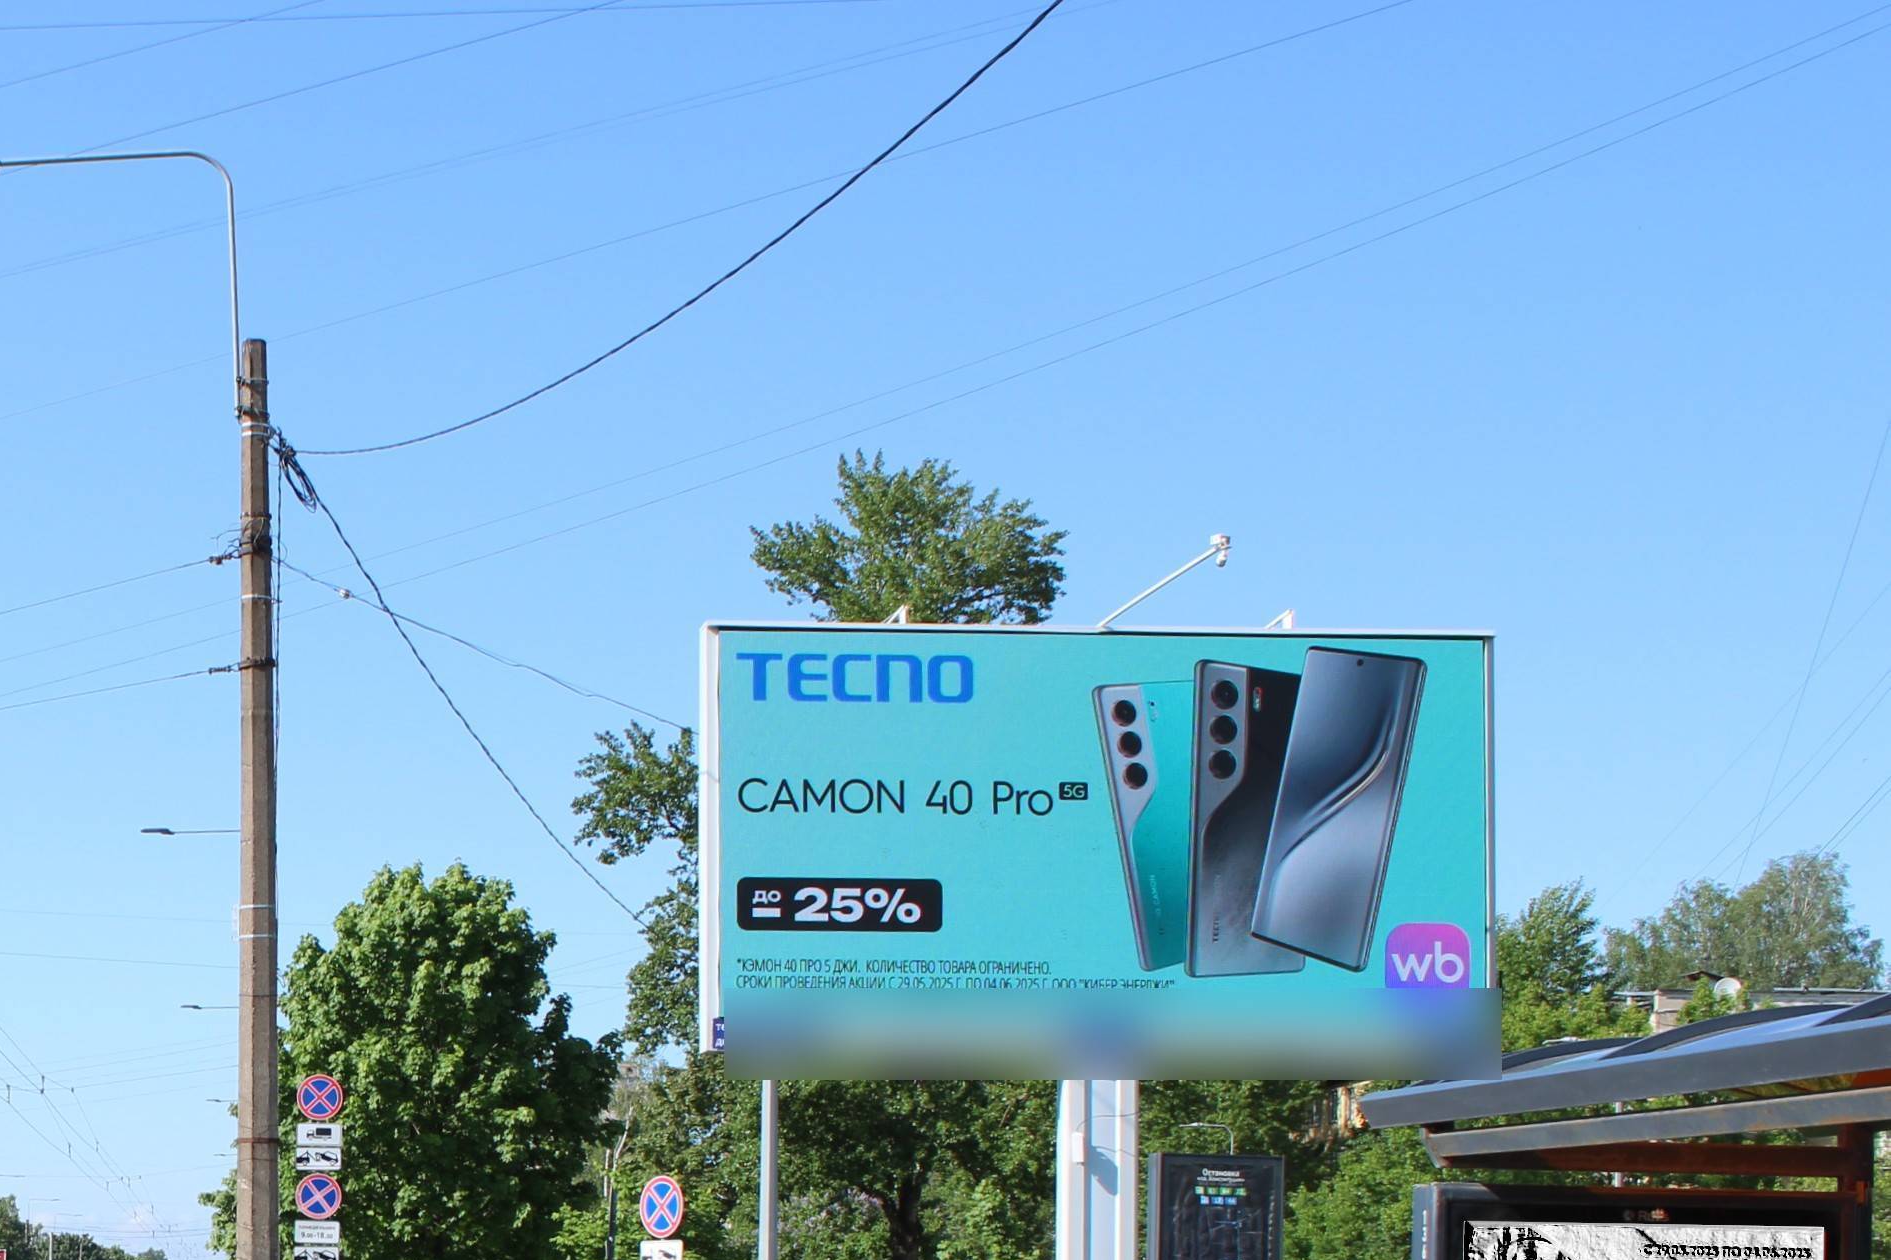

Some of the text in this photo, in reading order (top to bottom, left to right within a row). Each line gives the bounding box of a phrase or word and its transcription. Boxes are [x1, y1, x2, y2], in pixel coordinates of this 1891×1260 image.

[736, 652, 974, 704] TECNO
[737, 777, 1086, 817] CAMON 40 Pro 5G
[784, 958, 797, 973] 40
[799, 959, 822, 973] ПРО
[824, 959, 831, 973] 5
[833, 959, 860, 975] ДЖИ.
[865, 959, 936, 974] КОЛИЧЕСТВО
[939, 960, 976, 974] ТОВАРА
[978, 960, 1052, 975] ОГРАНИЧЕНО.
[1391, 941, 1465, 983] wb
[736, 974, 772, 989] СРОКИ
[775, 975, 846, 989] ПРОВЕДЕНИЯ
[897, 976, 953, 989] 29052025
[984, 977, 1040, 989] 04062025
[1722, 1245, 1742, 1257] ПО
